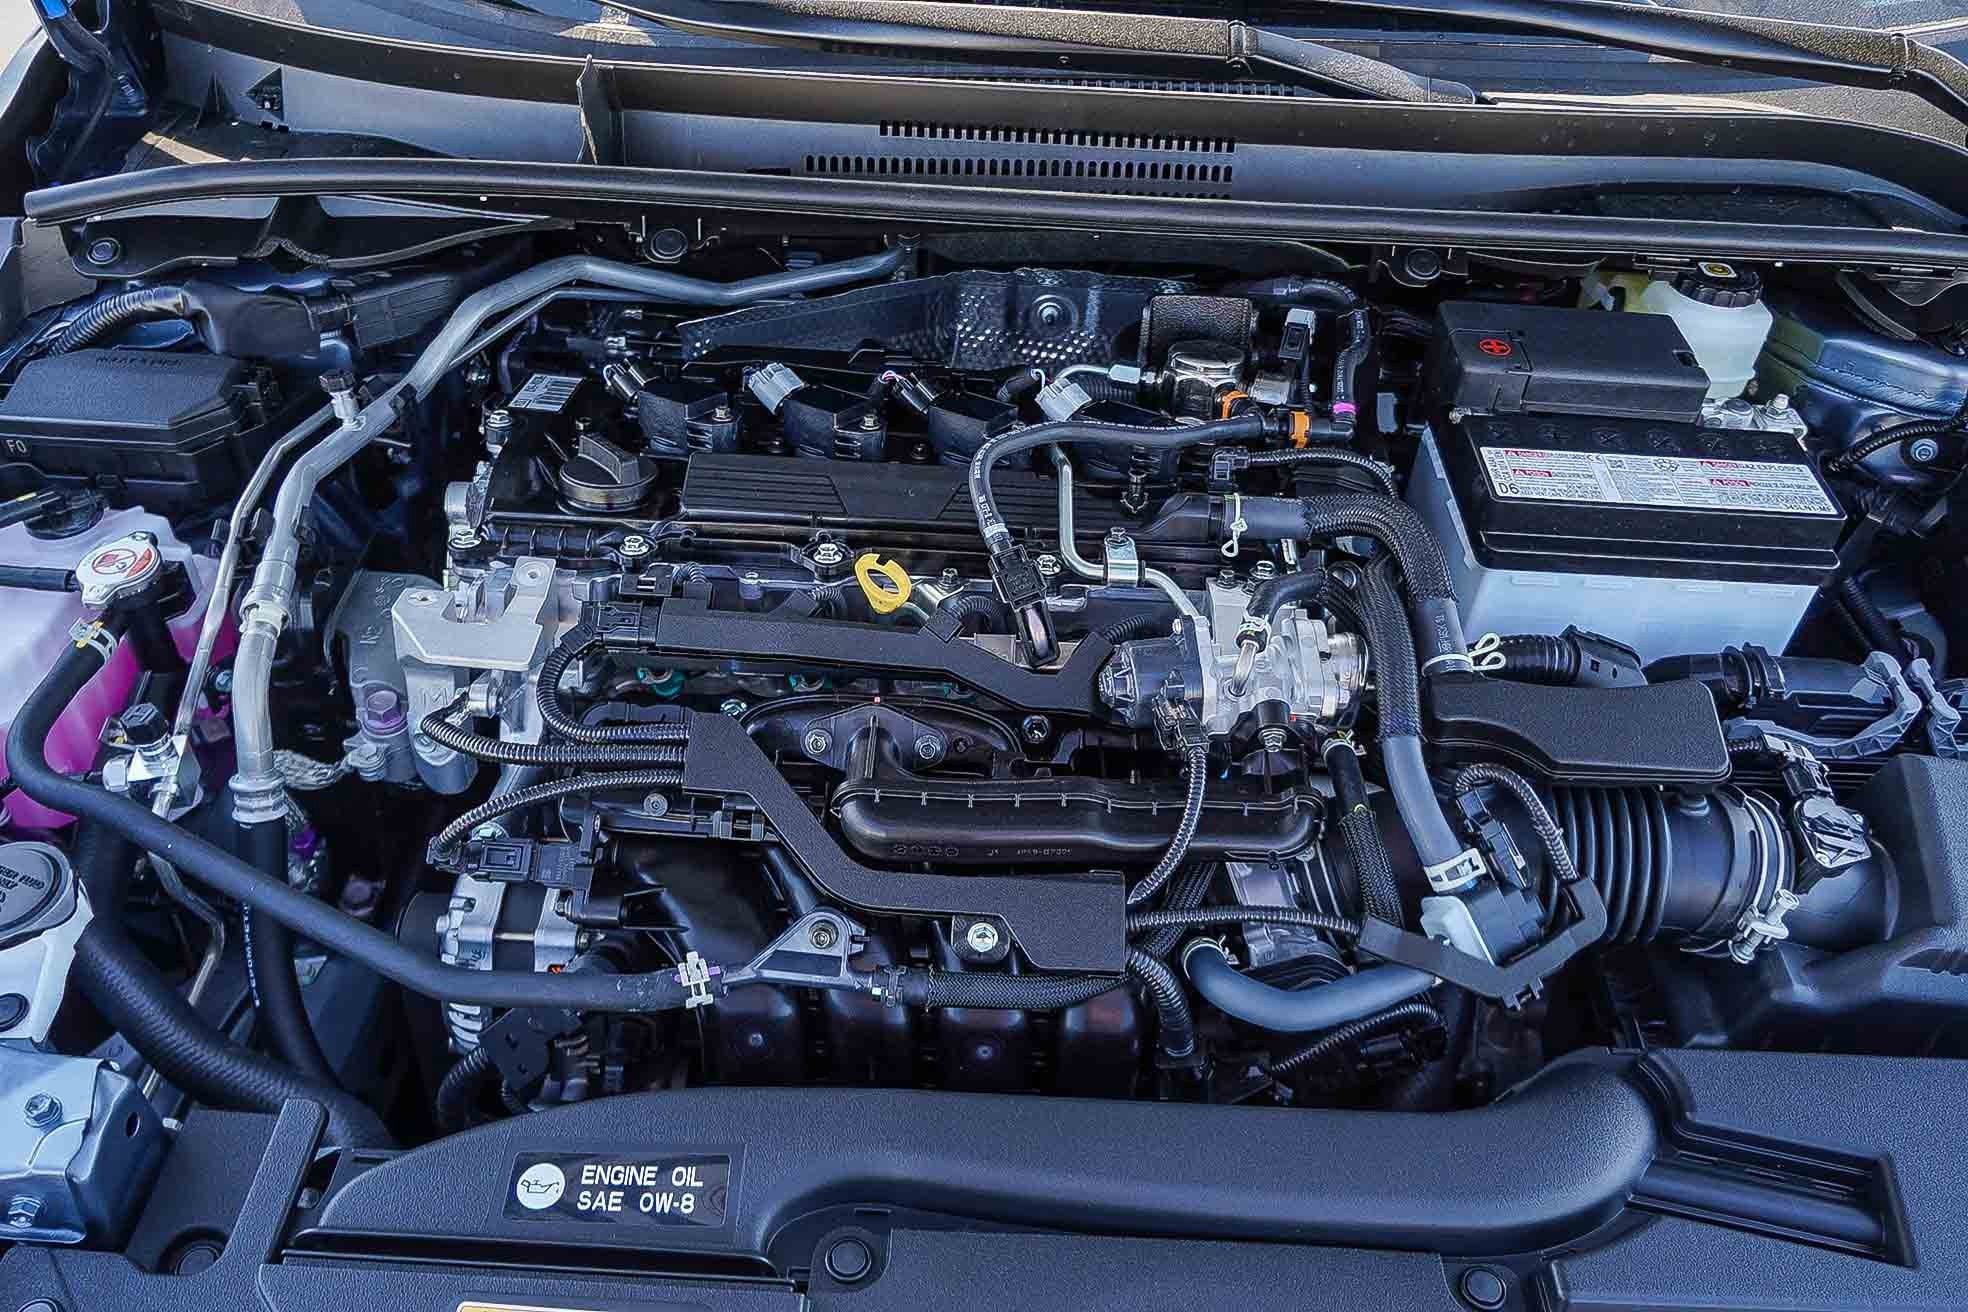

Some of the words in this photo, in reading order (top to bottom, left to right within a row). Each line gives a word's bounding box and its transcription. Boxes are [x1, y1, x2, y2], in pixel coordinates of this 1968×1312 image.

[1499, 482, 1519, 494] D6
[581, 1165, 657, 1186] ENGINE
[671, 1166, 703, 1187] OIL
[576, 1191, 624, 1212] SAE
